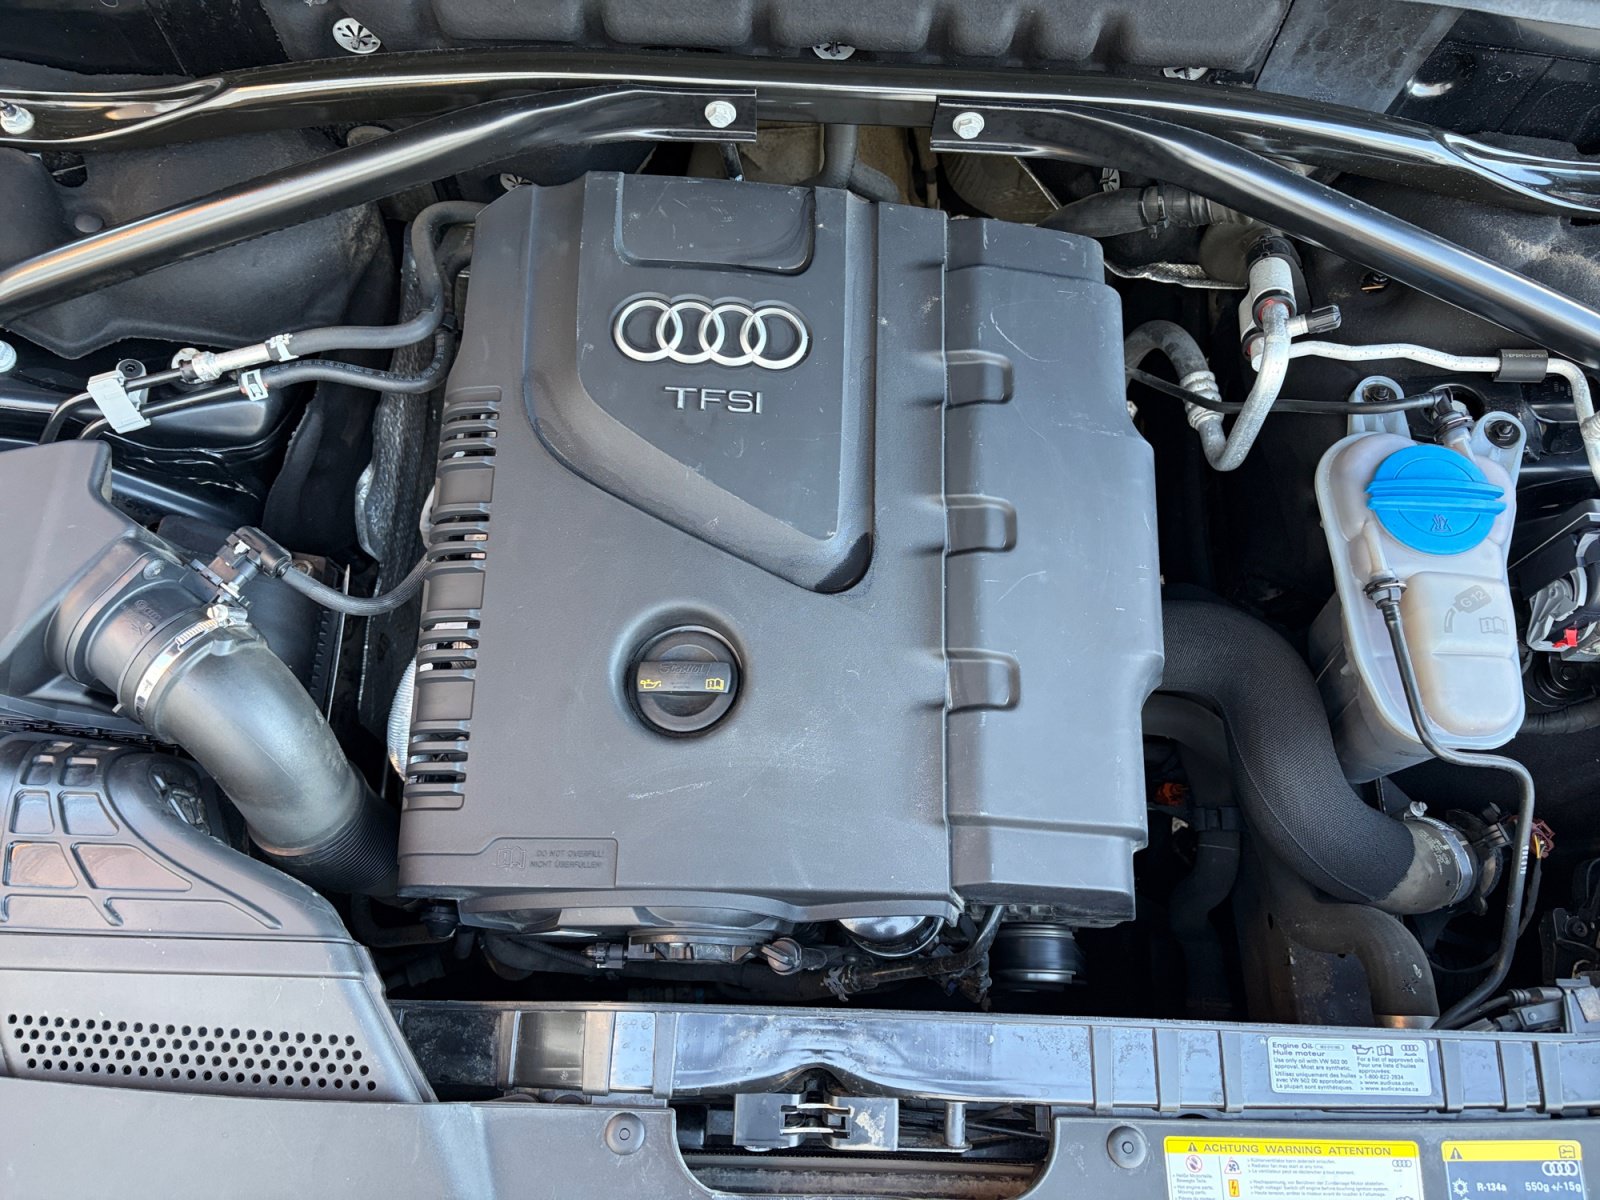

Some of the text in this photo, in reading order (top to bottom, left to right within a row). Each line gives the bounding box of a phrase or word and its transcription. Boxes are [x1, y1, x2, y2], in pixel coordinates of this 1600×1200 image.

[664, 386, 762, 414] TFSI
[1460, 590, 1486, 607] G12
[1204, 1143, 1391, 1156] ACHTUNG WARNING ATTENTION
[1477, 1182, 1507, 1191] R-134a
[1525, 1181, 1549, 1192] 550g
